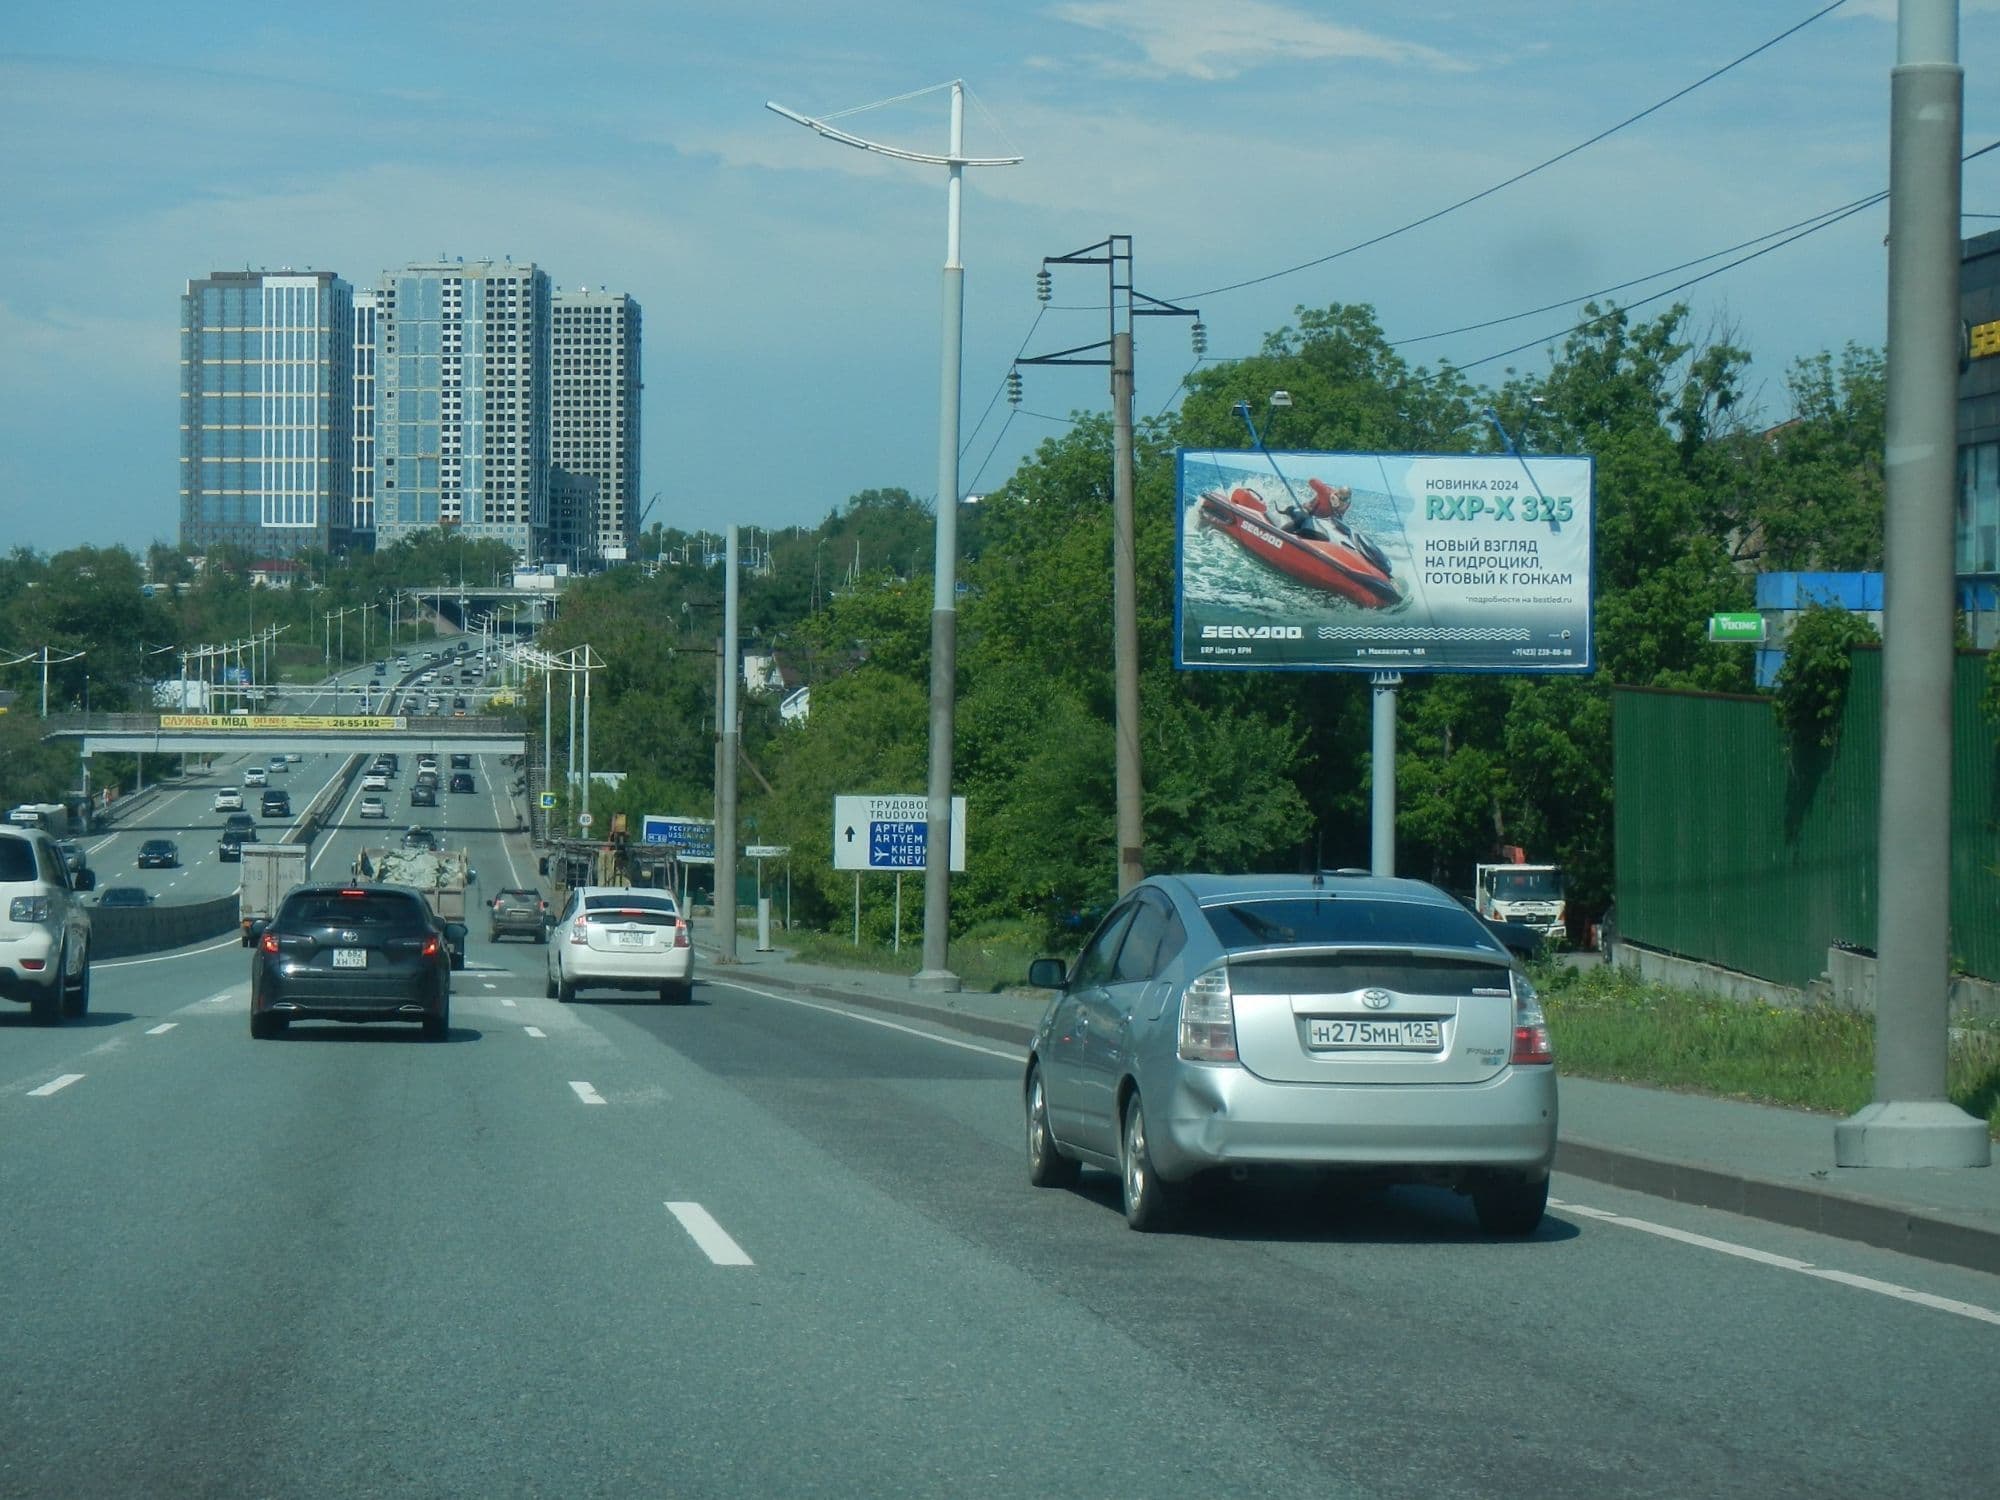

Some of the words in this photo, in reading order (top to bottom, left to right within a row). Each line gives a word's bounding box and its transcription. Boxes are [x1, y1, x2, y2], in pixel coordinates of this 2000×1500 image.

[1425, 479, 1488, 490] НОВИНКА
[1490, 480, 1519, 491] 2024
[1425, 494, 1516, 521] RXP-X
[1520, 496, 1574, 522] 325
[1425, 537, 1480, 552] НОВЫЙ
[1484, 540, 1538, 554] ВЗГЛЯД
[1425, 556, 1445, 568] НА
[1448, 556, 1543, 570] ГИДРОЦИКЛ,
[1425, 571, 1495, 585] ГОТОВЫЙ
[1500, 573, 1509, 585] К
[1512, 573, 1572, 585] ГОНКАМ
[162, 716, 209, 726] СЛУЖБА
[221, 717, 248, 727] МВД
[875, 823, 914, 833] АРТЁМ
[875, 834, 923, 843] ARTYEM
[1404, 1023, 1434, 1039] 125
